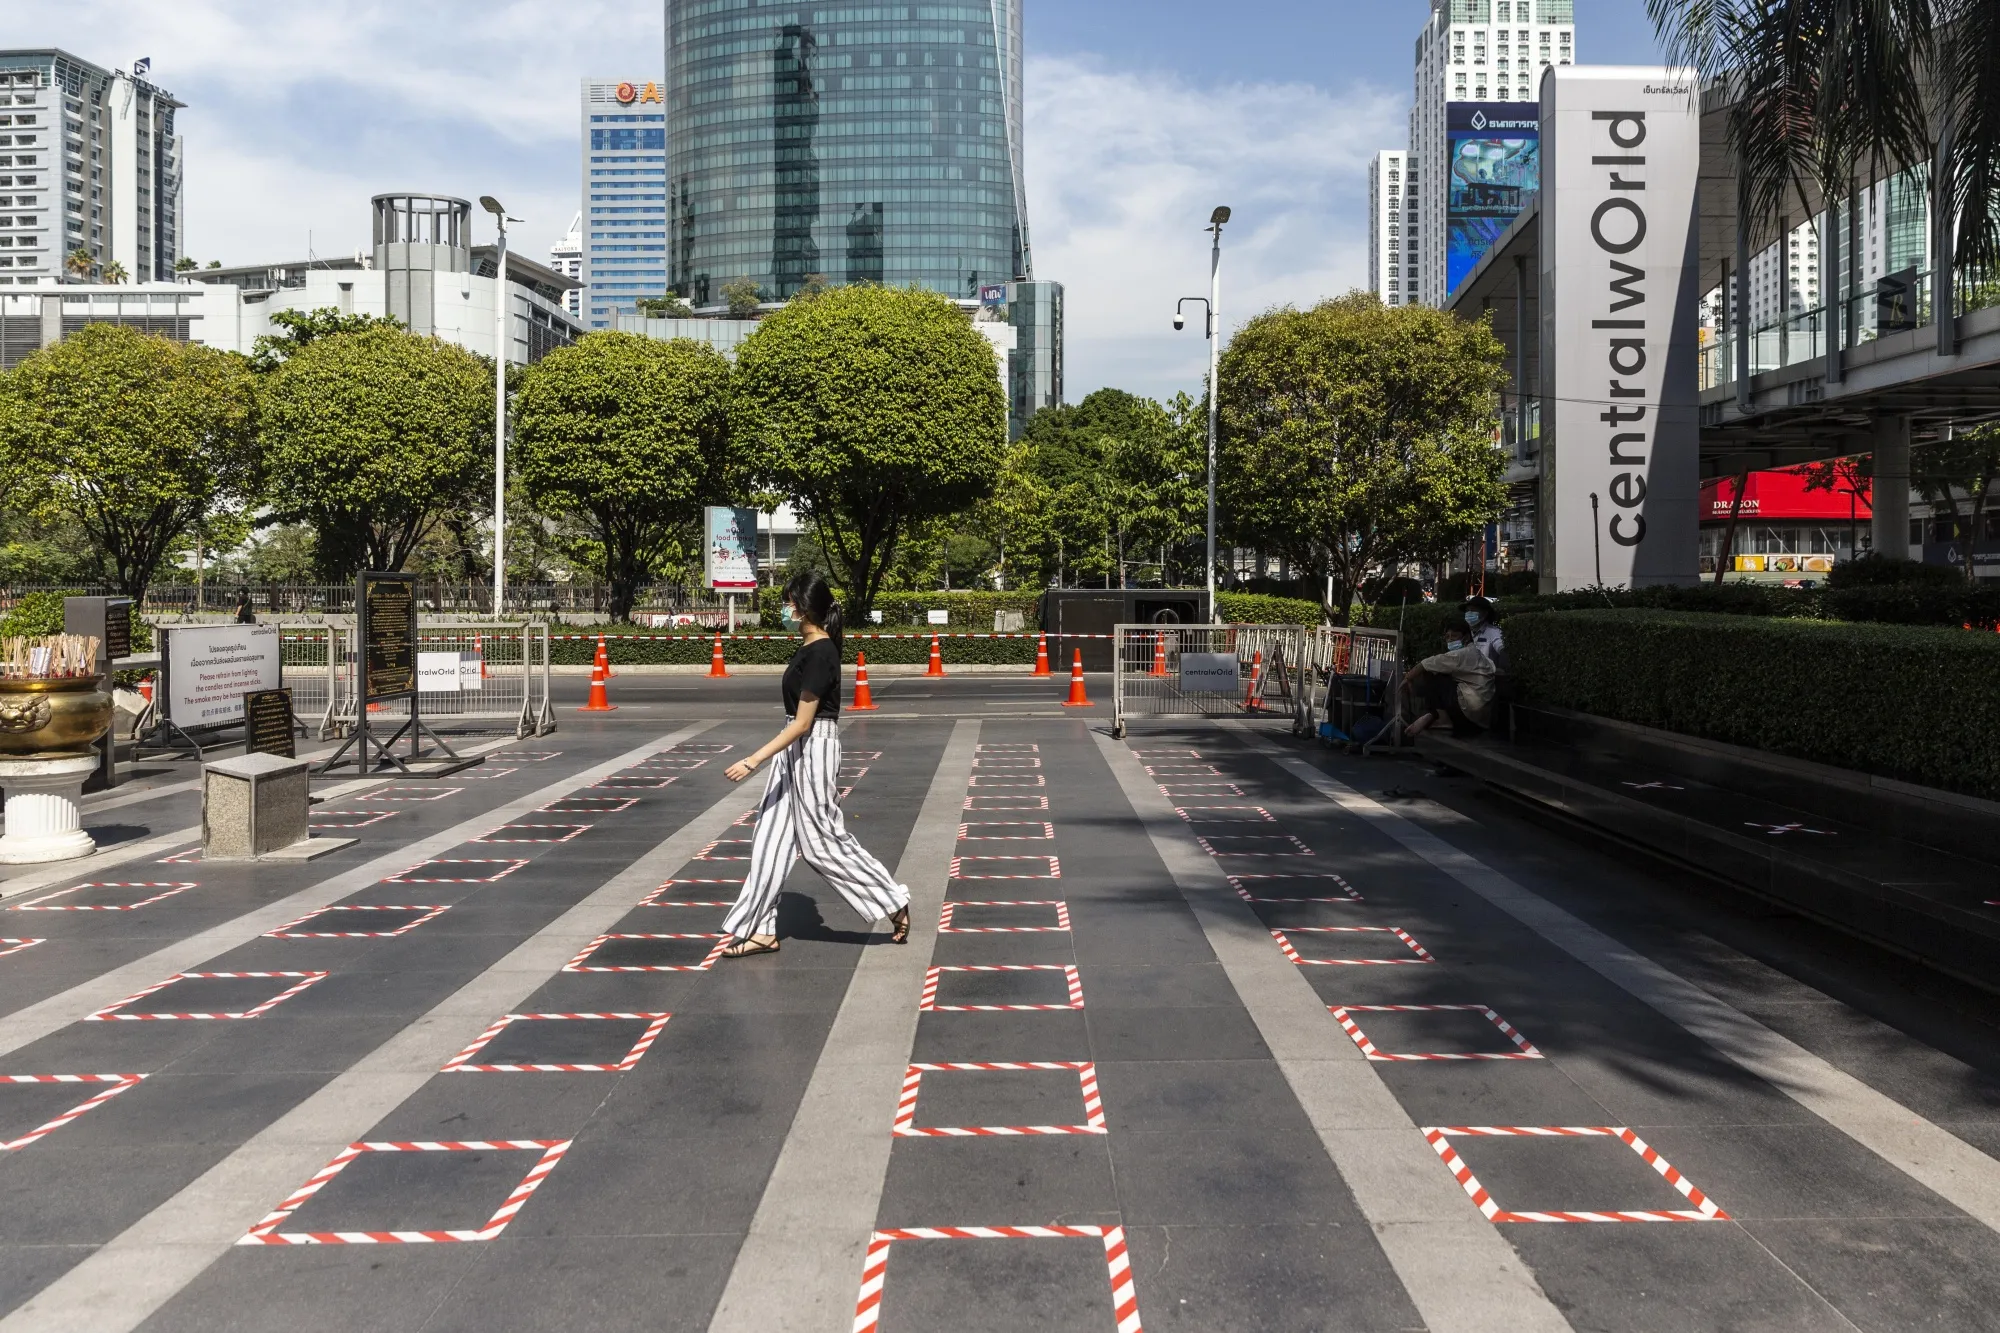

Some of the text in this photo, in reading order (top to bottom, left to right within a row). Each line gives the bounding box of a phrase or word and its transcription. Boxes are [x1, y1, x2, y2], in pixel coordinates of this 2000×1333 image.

[115, 68, 174, 100] PLATINUM
[1590, 111, 1647, 547] centralwOrld
[242, 669, 258, 677] lighting
[418, 668, 455, 676] tralwOrld
[1184, 668, 1233, 676] centralwOrld
[205, 683, 223, 691] candles
[184, 697, 194, 705] The
[195, 695, 211, 703] smoke
